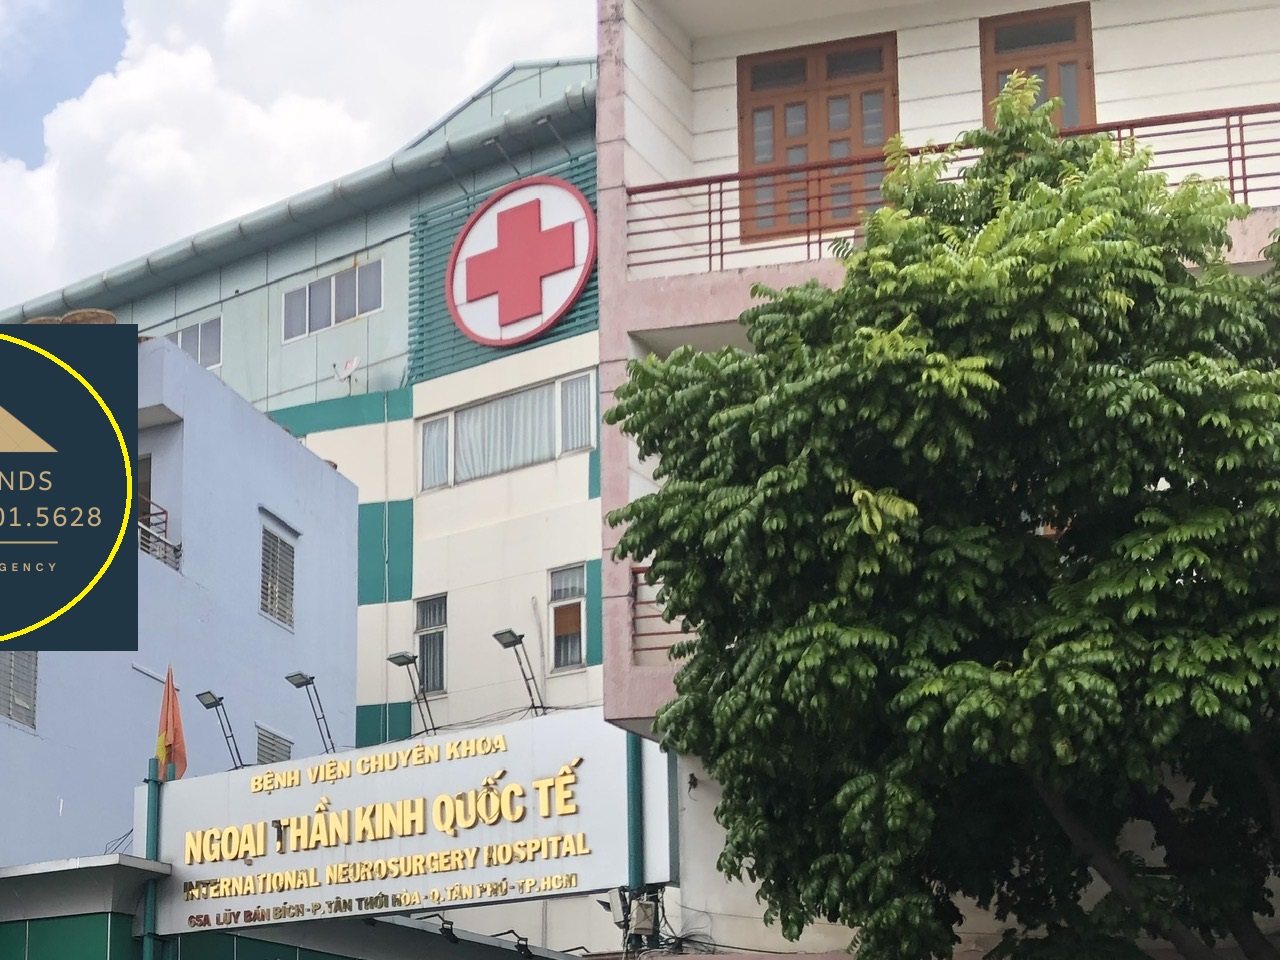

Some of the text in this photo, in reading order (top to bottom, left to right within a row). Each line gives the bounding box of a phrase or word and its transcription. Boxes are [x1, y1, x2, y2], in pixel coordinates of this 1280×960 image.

[250, 734, 508, 795] BỆNH VIỆN CHUYÊN KHOA
[184, 757, 584, 866] NGOẠI THẦN KINH QUỐC TẾ
[183, 832, 591, 901] INTERNATIONAL NEUROSURGERY HOSPITAL
[187, 914, 212, 928] 65A
[215, 908, 240, 926] LŨY
[243, 905, 270, 923] BÁN
[355, 891, 390, 911] THỚI
[391, 889, 421, 906] HÒA
